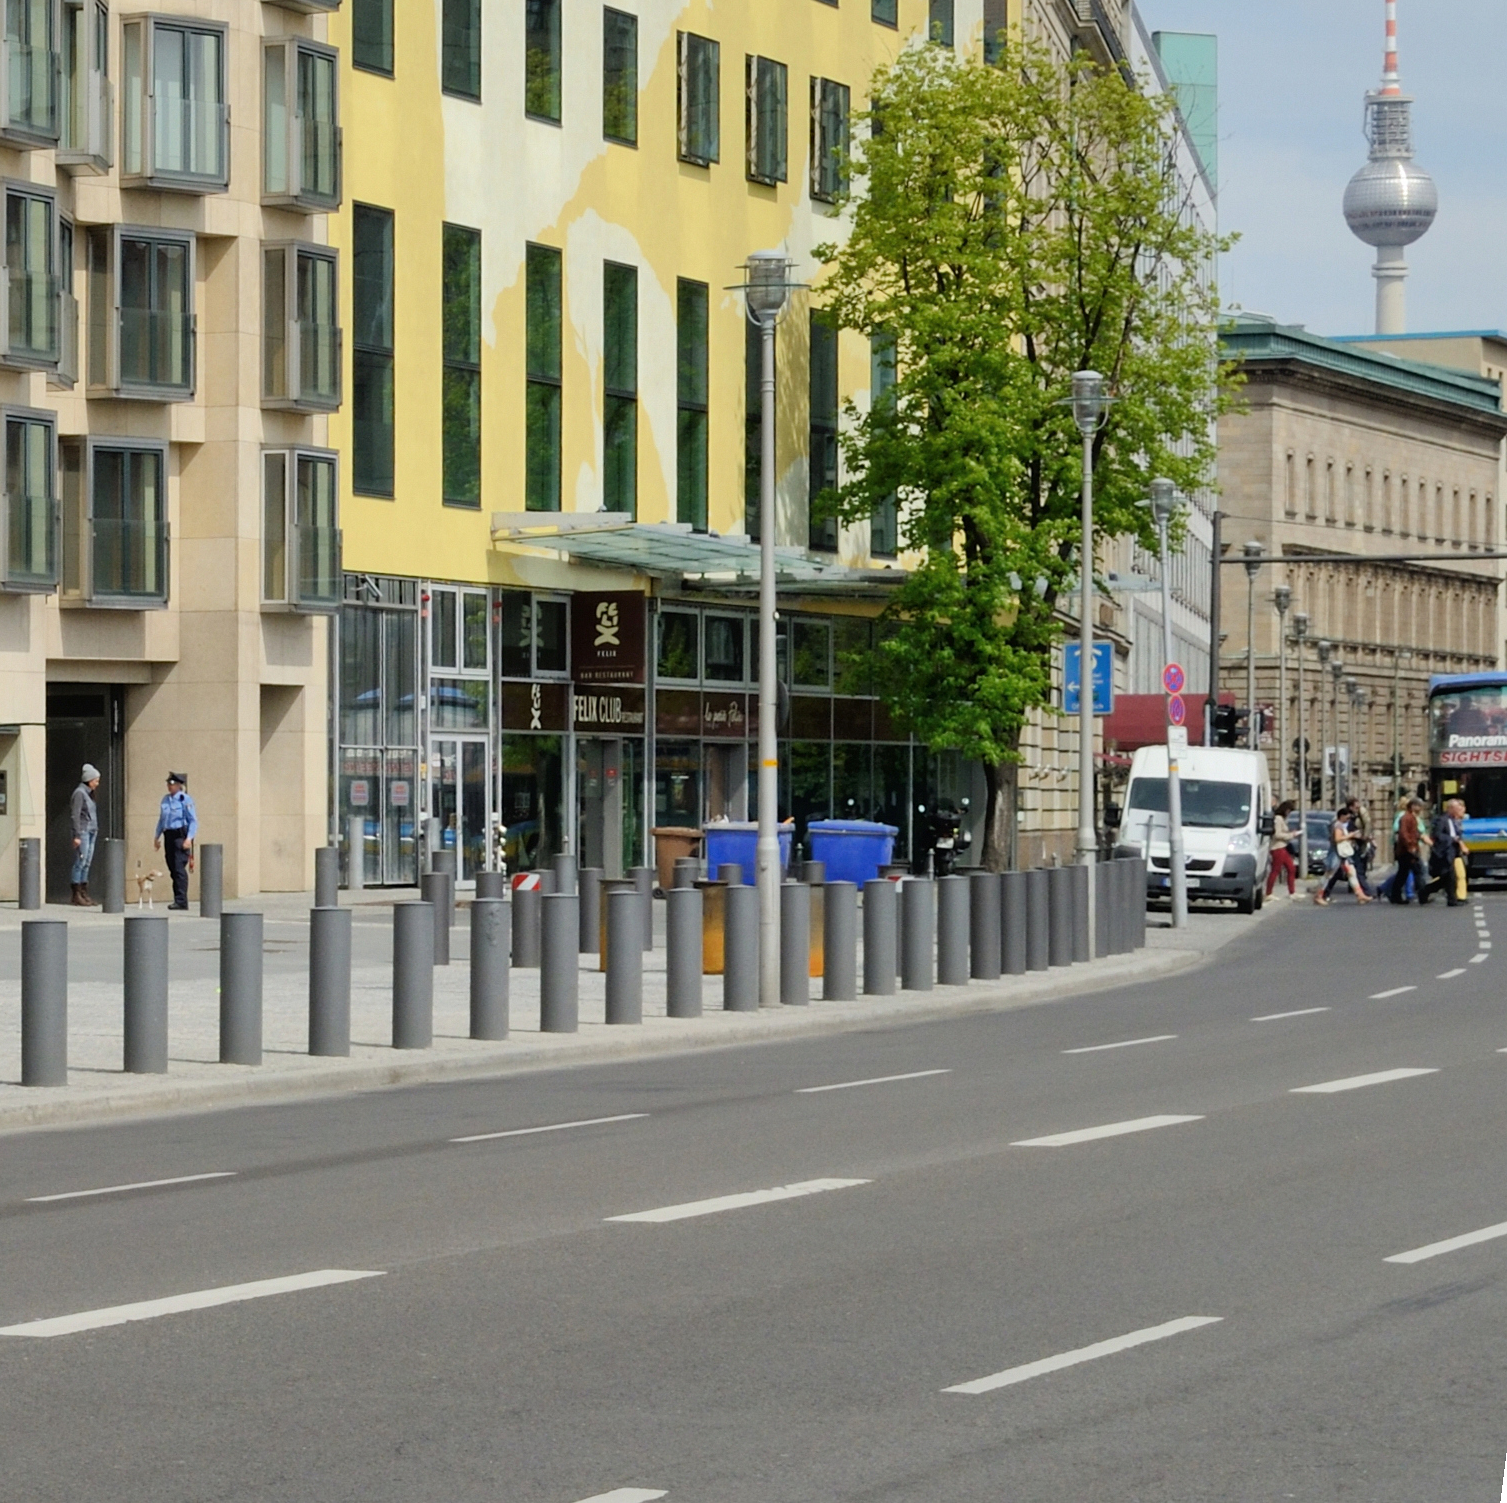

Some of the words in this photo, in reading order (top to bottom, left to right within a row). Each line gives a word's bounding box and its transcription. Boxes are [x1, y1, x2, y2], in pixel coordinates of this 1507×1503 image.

[573, 695, 598, 722] FELIX
[599, 696, 622, 724] CLUB
[1448, 734, 1507, 748] Panoram
